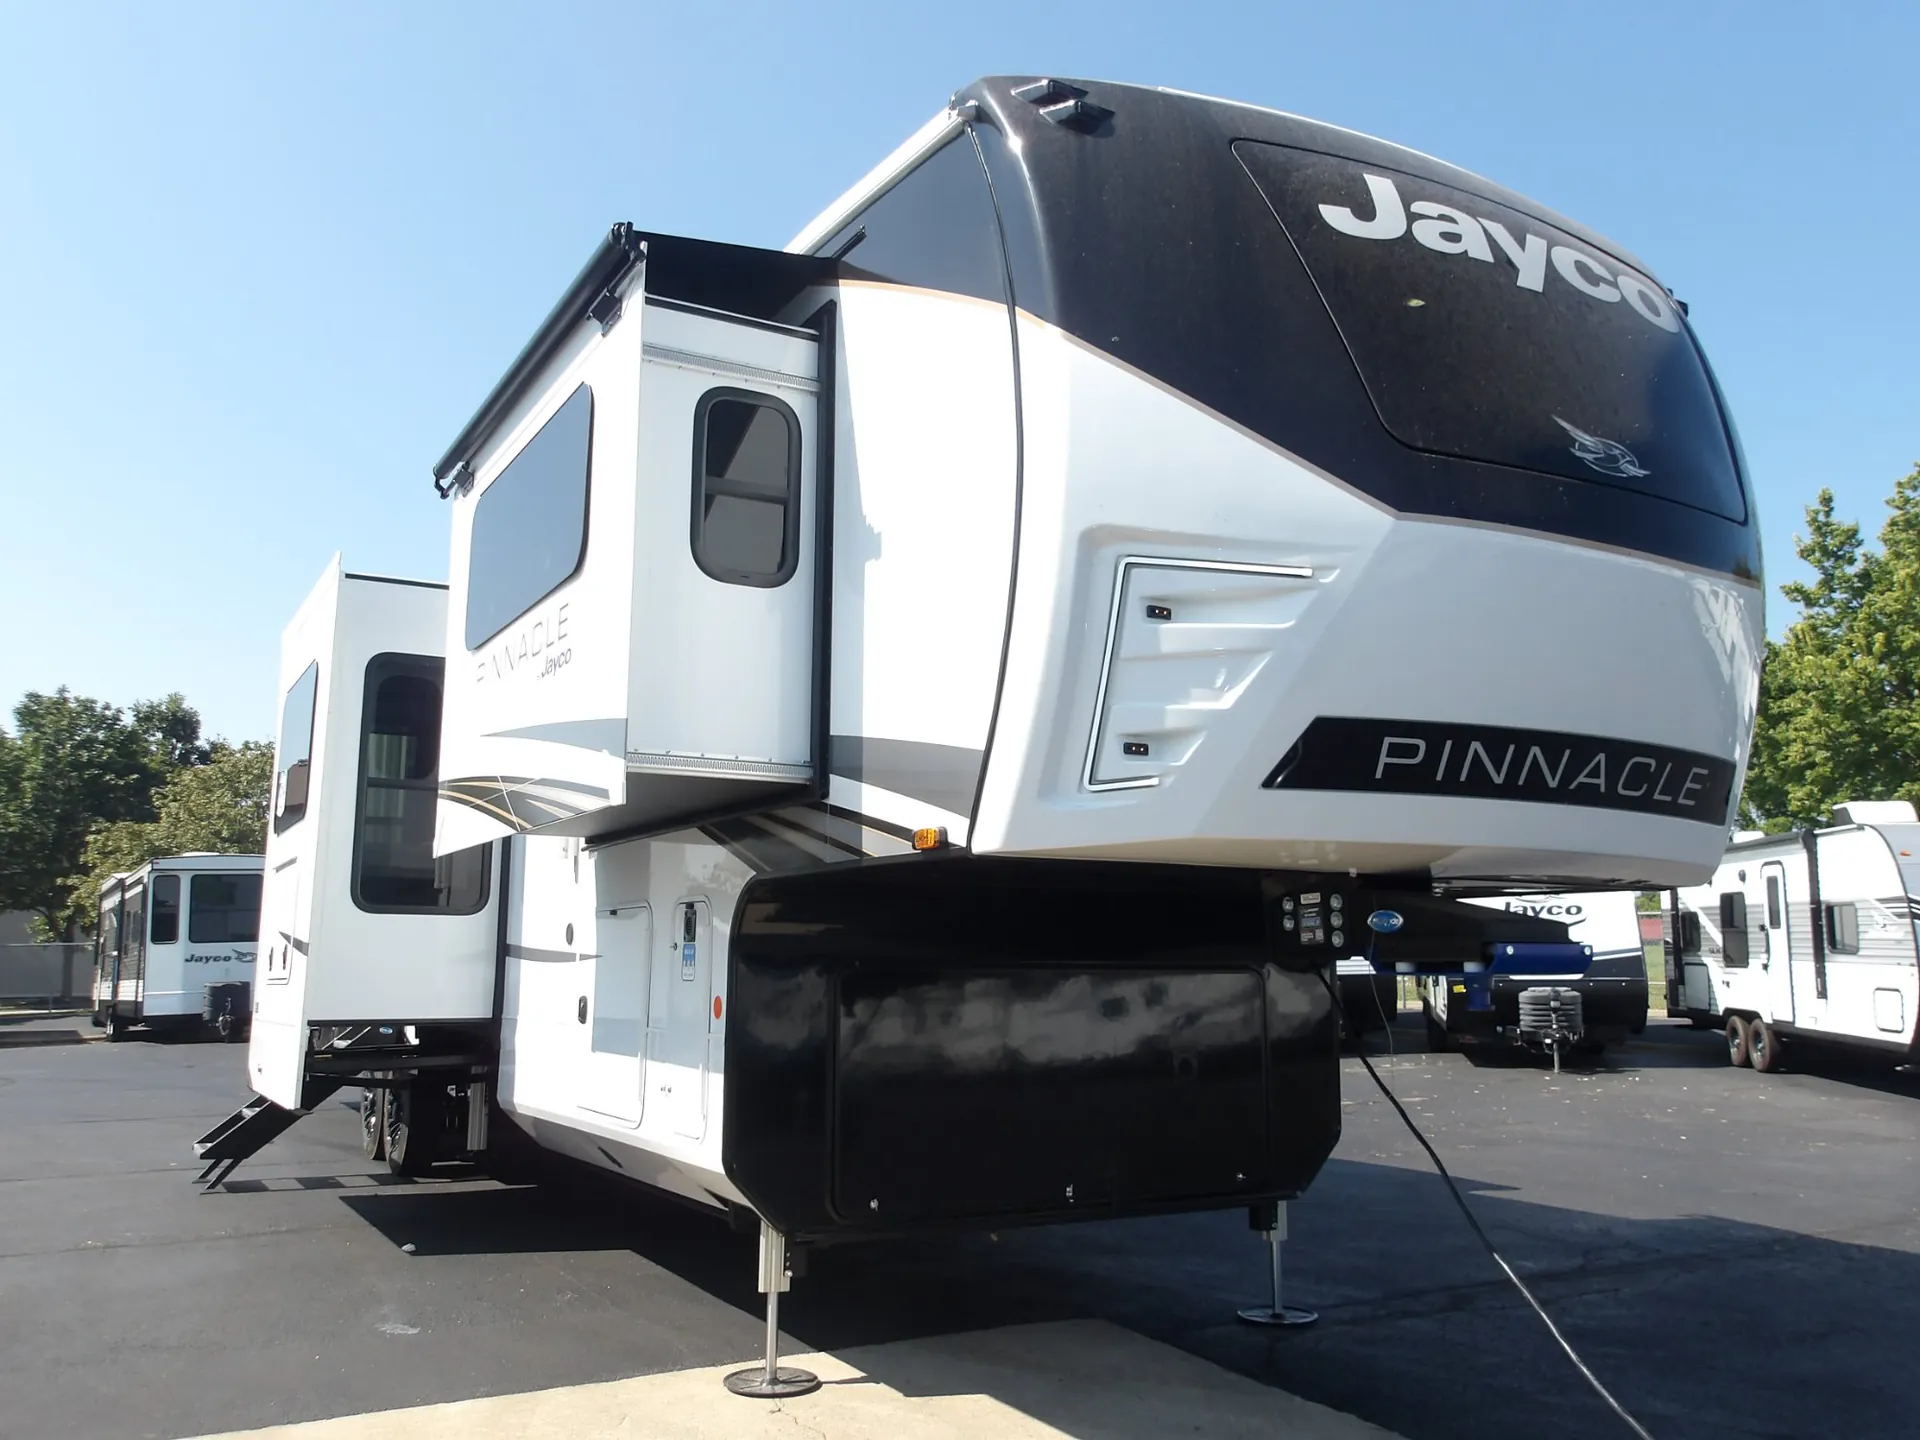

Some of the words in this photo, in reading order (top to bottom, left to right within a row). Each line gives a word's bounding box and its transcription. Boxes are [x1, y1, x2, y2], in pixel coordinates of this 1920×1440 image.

[1318, 173, 1680, 333] Jayco
[476, 602, 569, 683] PNNACLE
[1374, 736, 1709, 806] PINNACLE
[184, 953, 232, 964] Jayco
